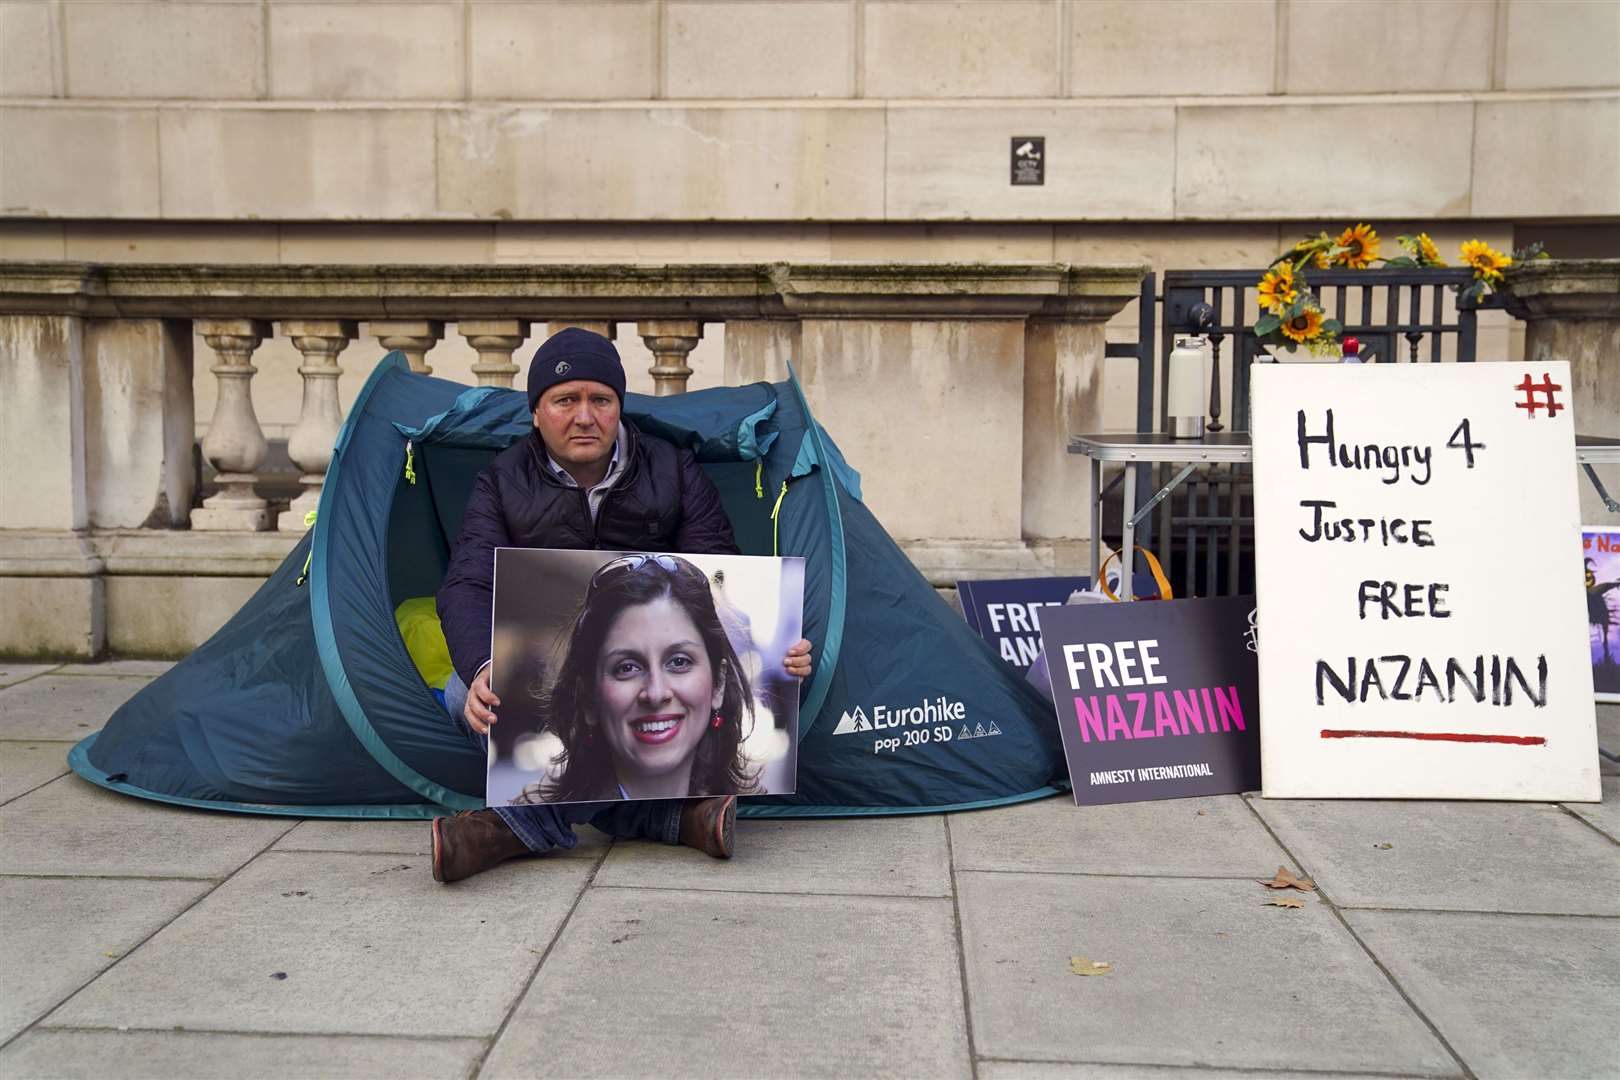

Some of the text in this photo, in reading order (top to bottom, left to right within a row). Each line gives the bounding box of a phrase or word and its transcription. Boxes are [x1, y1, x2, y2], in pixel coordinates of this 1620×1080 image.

[1297, 408, 1486, 485] Hungry 4
[986, 602, 1062, 633] FRE
[1358, 579, 1451, 620] FREE
[999, 636, 1044, 667] AN
[1062, 639, 1168, 690] FREE
[1315, 653, 1548, 708] NAZANIN
[873, 696, 966, 730] Eurohike
[1073, 685, 1246, 744] NAZANIN
[874, 726, 953, 754] pop 200 SD
[1090, 762, 1214, 786] AMNESTY INTERNATIONAL
